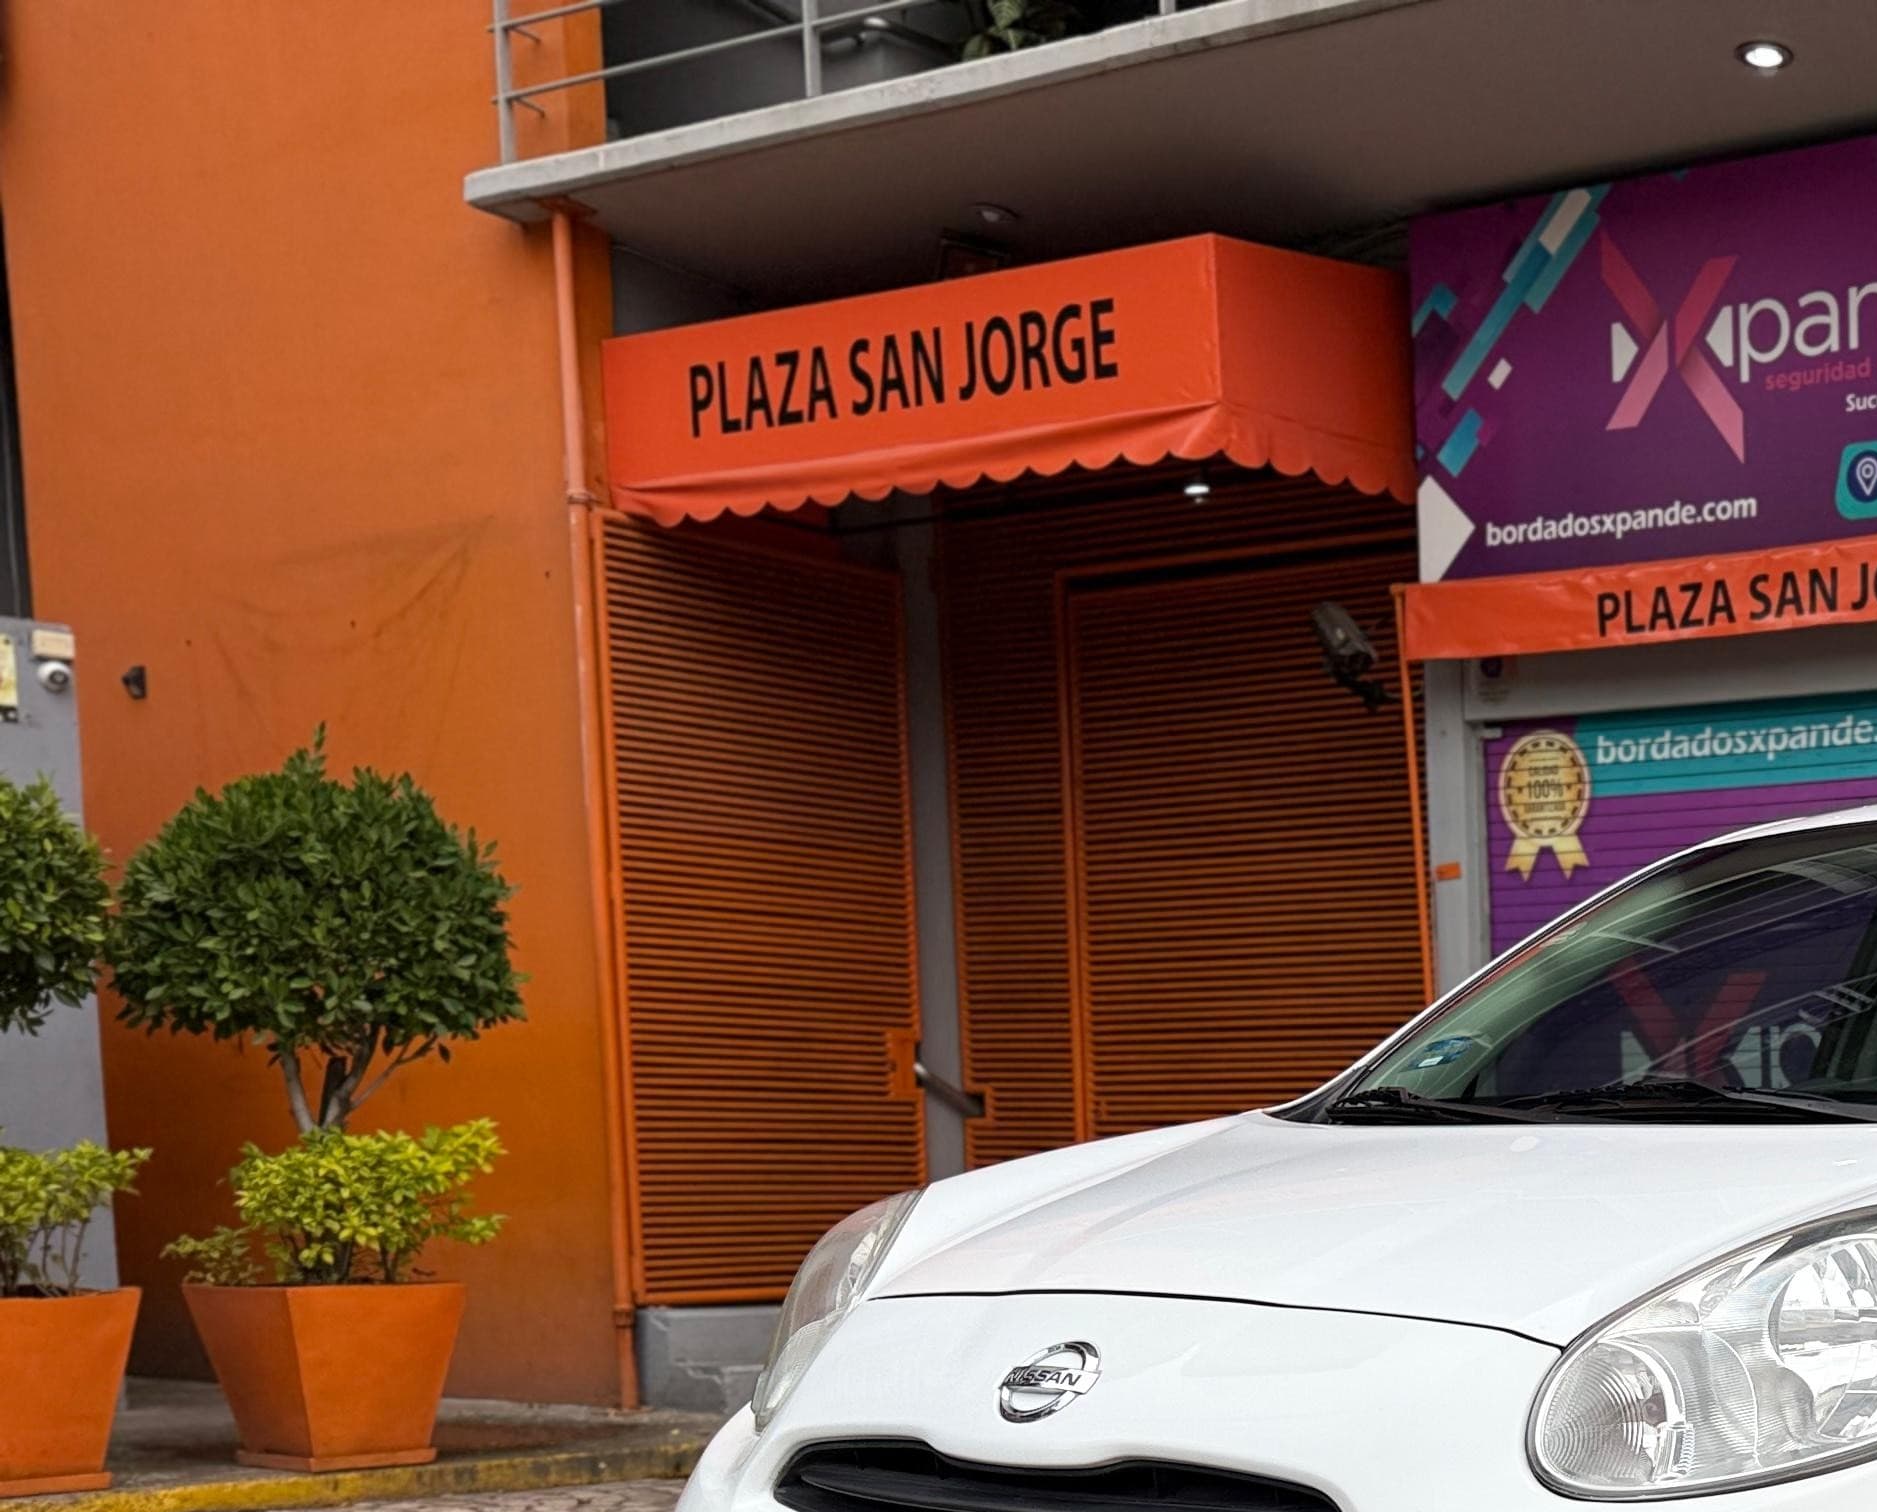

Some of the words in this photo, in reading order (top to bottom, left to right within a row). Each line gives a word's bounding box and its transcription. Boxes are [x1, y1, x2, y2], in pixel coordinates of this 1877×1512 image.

[688, 345, 838, 438] PLAZA
[849, 328, 945, 416] SAN
[958, 298, 1119, 402] JORGE
[1765, 358, 1871, 391] seguridad
[1485, 493, 1757, 548] bordadosxpande.com
[1599, 581, 1735, 637] PLAZA
[1749, 568, 1840, 623] SAN
[1527, 779, 1564, 799] 100%
[1005, 1368, 1082, 1387] NISSAN
